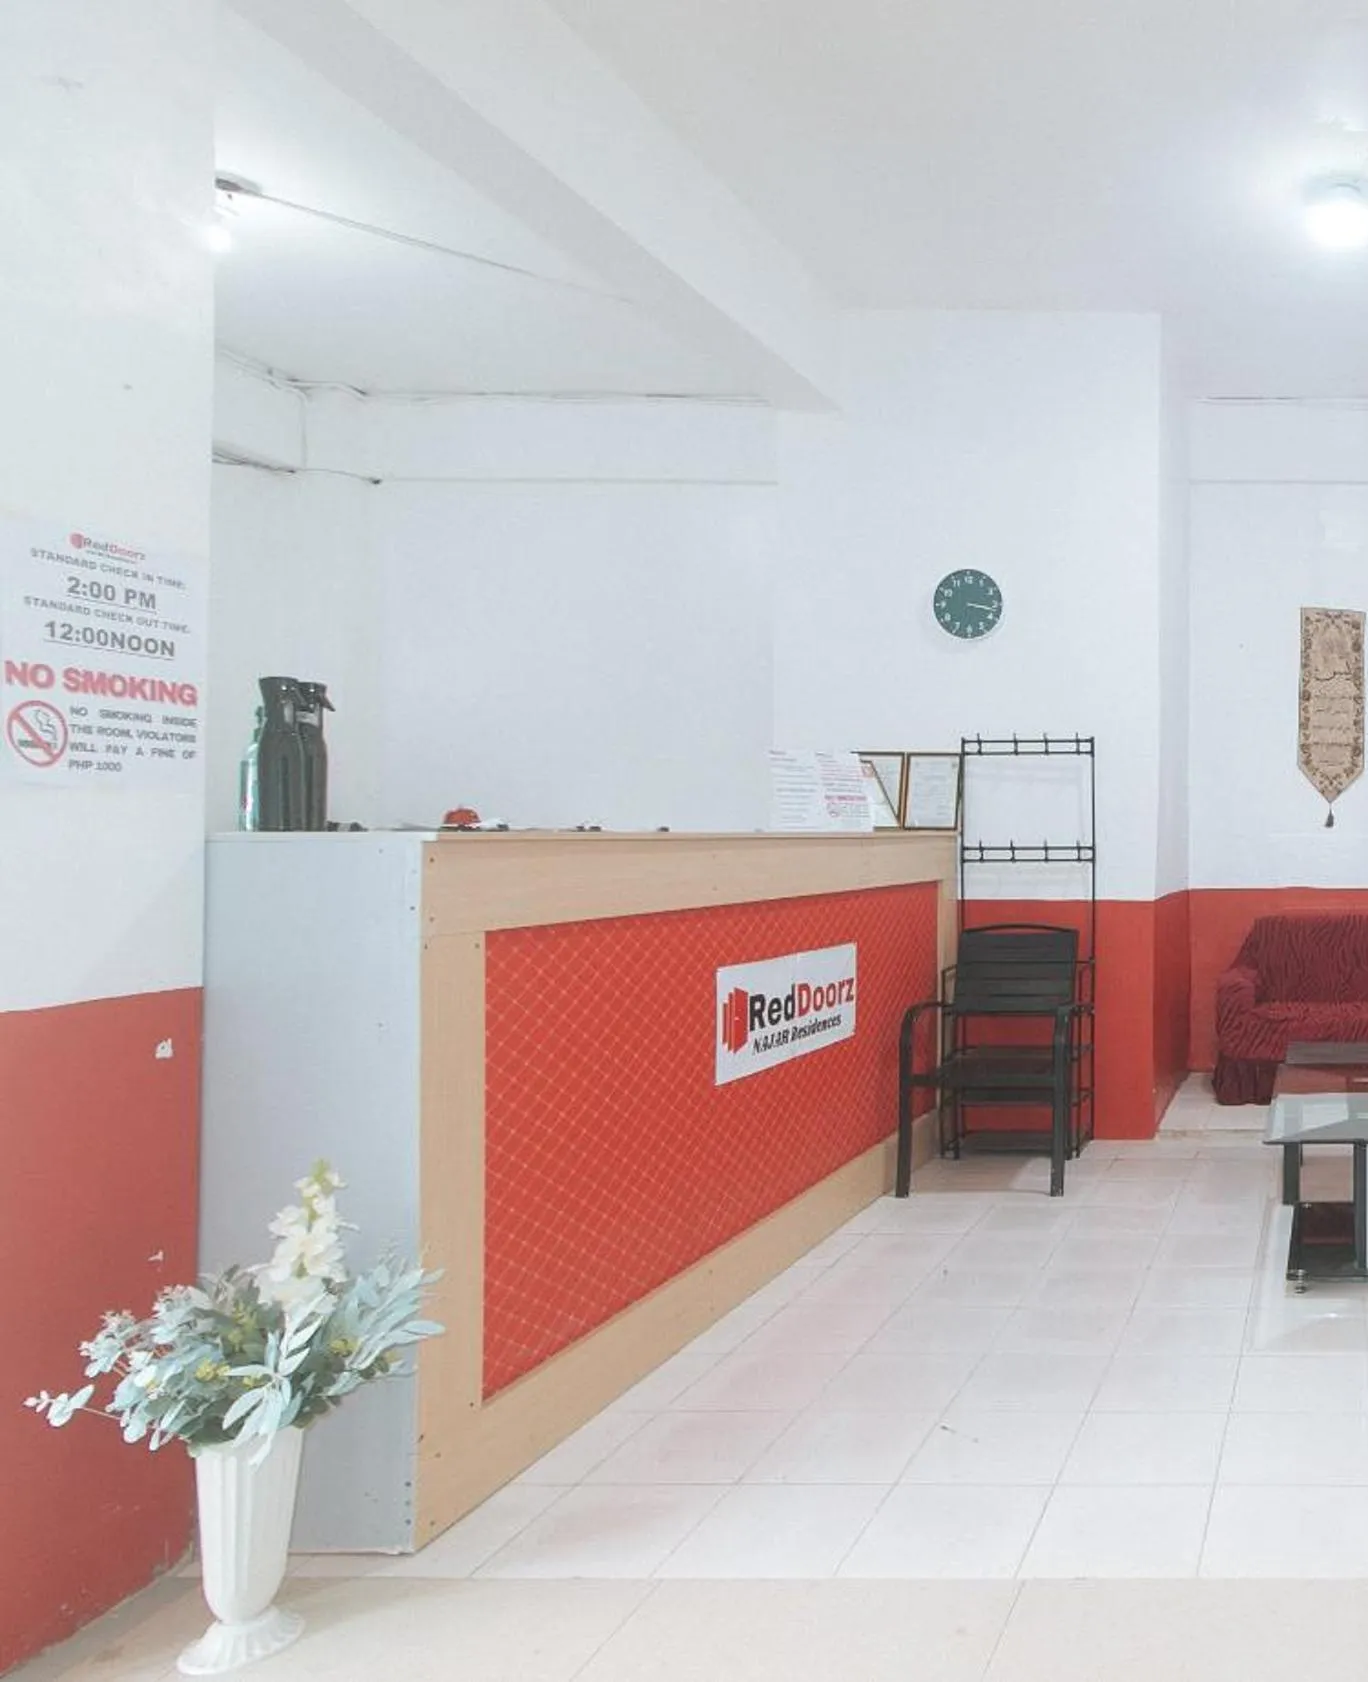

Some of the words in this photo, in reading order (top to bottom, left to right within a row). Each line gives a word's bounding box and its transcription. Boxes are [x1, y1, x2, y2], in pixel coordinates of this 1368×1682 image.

[31, 548, 97, 570] STANDARD
[100, 563, 139, 579] CHECK
[143, 573, 154, 582] IN
[67, 576, 116, 601] 2:00
[124, 588, 157, 609] PM
[24, 596, 91, 616] STANDARD
[94, 609, 133, 623] CHECK
[136, 616, 158, 629] OUT
[44, 620, 175, 657] 12:00NOON
[4, 660, 56, 690] NO
[63, 667, 198, 707] SMOKING
[69, 706, 88, 717] NO
[99, 708, 152, 723] SMOKING
[162, 716, 198, 728] INSIDE
[70, 724, 93, 735] THE
[69, 759, 94, 770] PHP
[96, 761, 122, 772] 1000
[70, 742, 96, 753] WILL
[106, 744, 128, 755] PAY
[136, 747, 145, 757] A
[152, 748, 176, 759] FINE
[183, 749, 196, 760] OF
[749, 977, 855, 1032] RedDoorz
[752, 1029, 790, 1056] NAJAR
[791, 1013, 842, 1042] Residences
